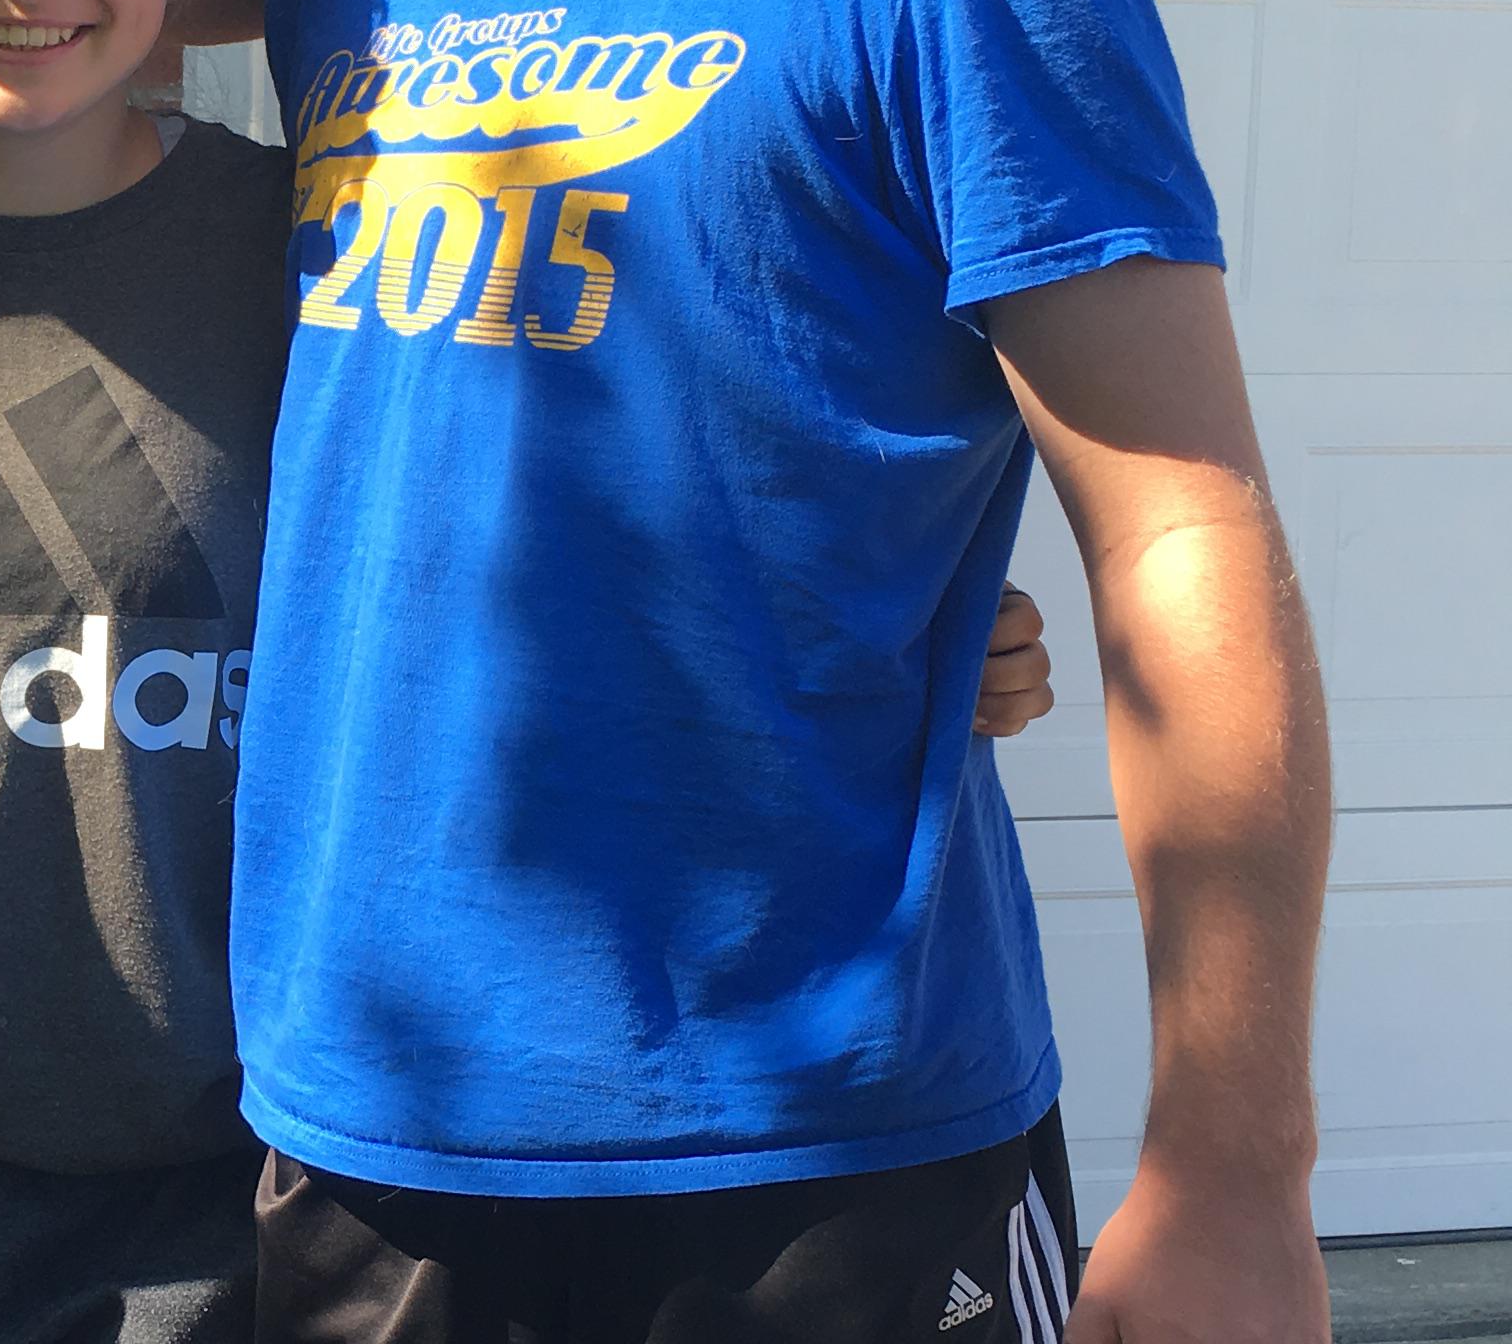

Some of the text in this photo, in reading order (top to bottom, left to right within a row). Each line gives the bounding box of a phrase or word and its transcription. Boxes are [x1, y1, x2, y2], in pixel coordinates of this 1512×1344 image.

[428, 7, 568, 55] Groups
[297, 30, 747, 146] Awesome
[299, 177, 630, 351] 2015
[938, 1293, 994, 1332] adidas
